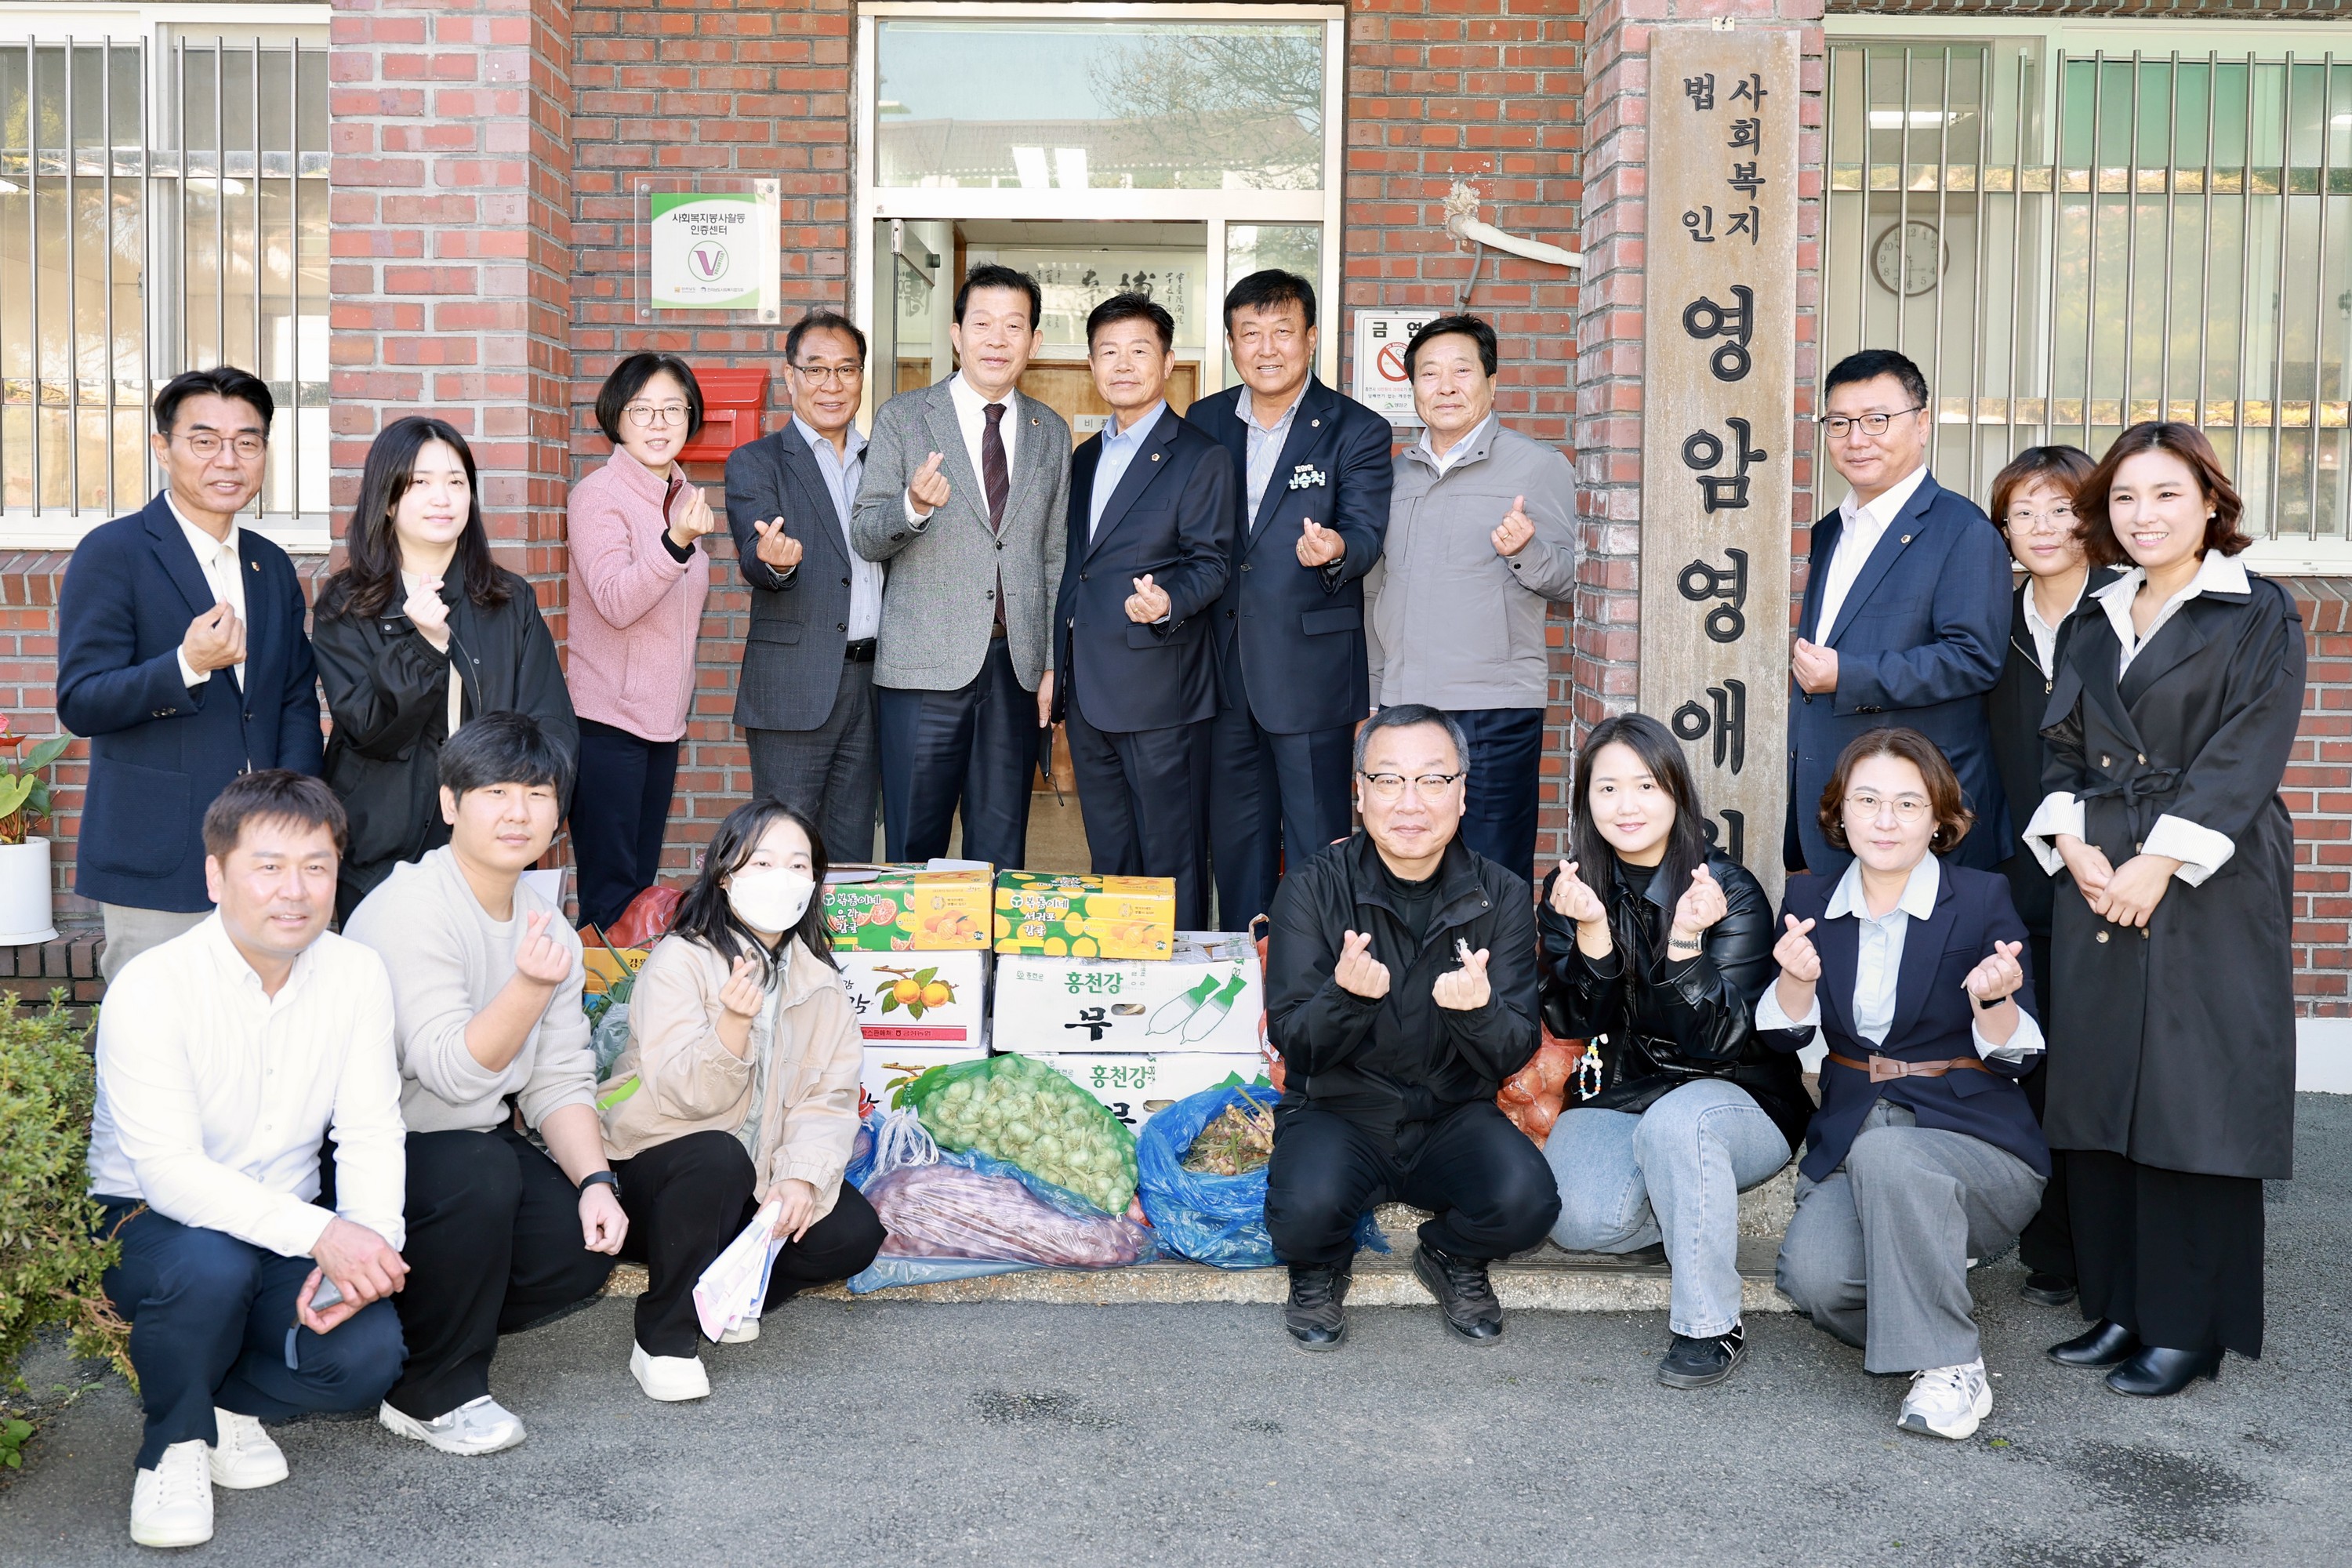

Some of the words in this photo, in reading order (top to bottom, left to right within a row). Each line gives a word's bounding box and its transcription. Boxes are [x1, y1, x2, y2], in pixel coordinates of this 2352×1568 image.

[1725, 72, 1768, 245] 사회복지
[672, 212, 746, 223] 사회복지봉사활동
[691, 225, 728, 235] 인증센터
[1884, 242, 1893, 251] 10
[1883, 267, 1889, 276] 8
[1289, 470, 1327, 490] 신승철
[837, 893, 881, 906] 복동이네
[1025, 896, 1069, 909] 복동이네
[1024, 912, 1056, 922] 서귀포
[837, 922, 858, 934] 감귤
[1023, 925, 1047, 938] 감귤
[973, 931, 985, 941] 5kg
[1156, 942, 1167, 950] 5kg
[1064, 971, 1123, 995] 홍천강
[1064, 1007, 1112, 1041] 무
[1089, 1065, 1149, 1089] 홍천강
